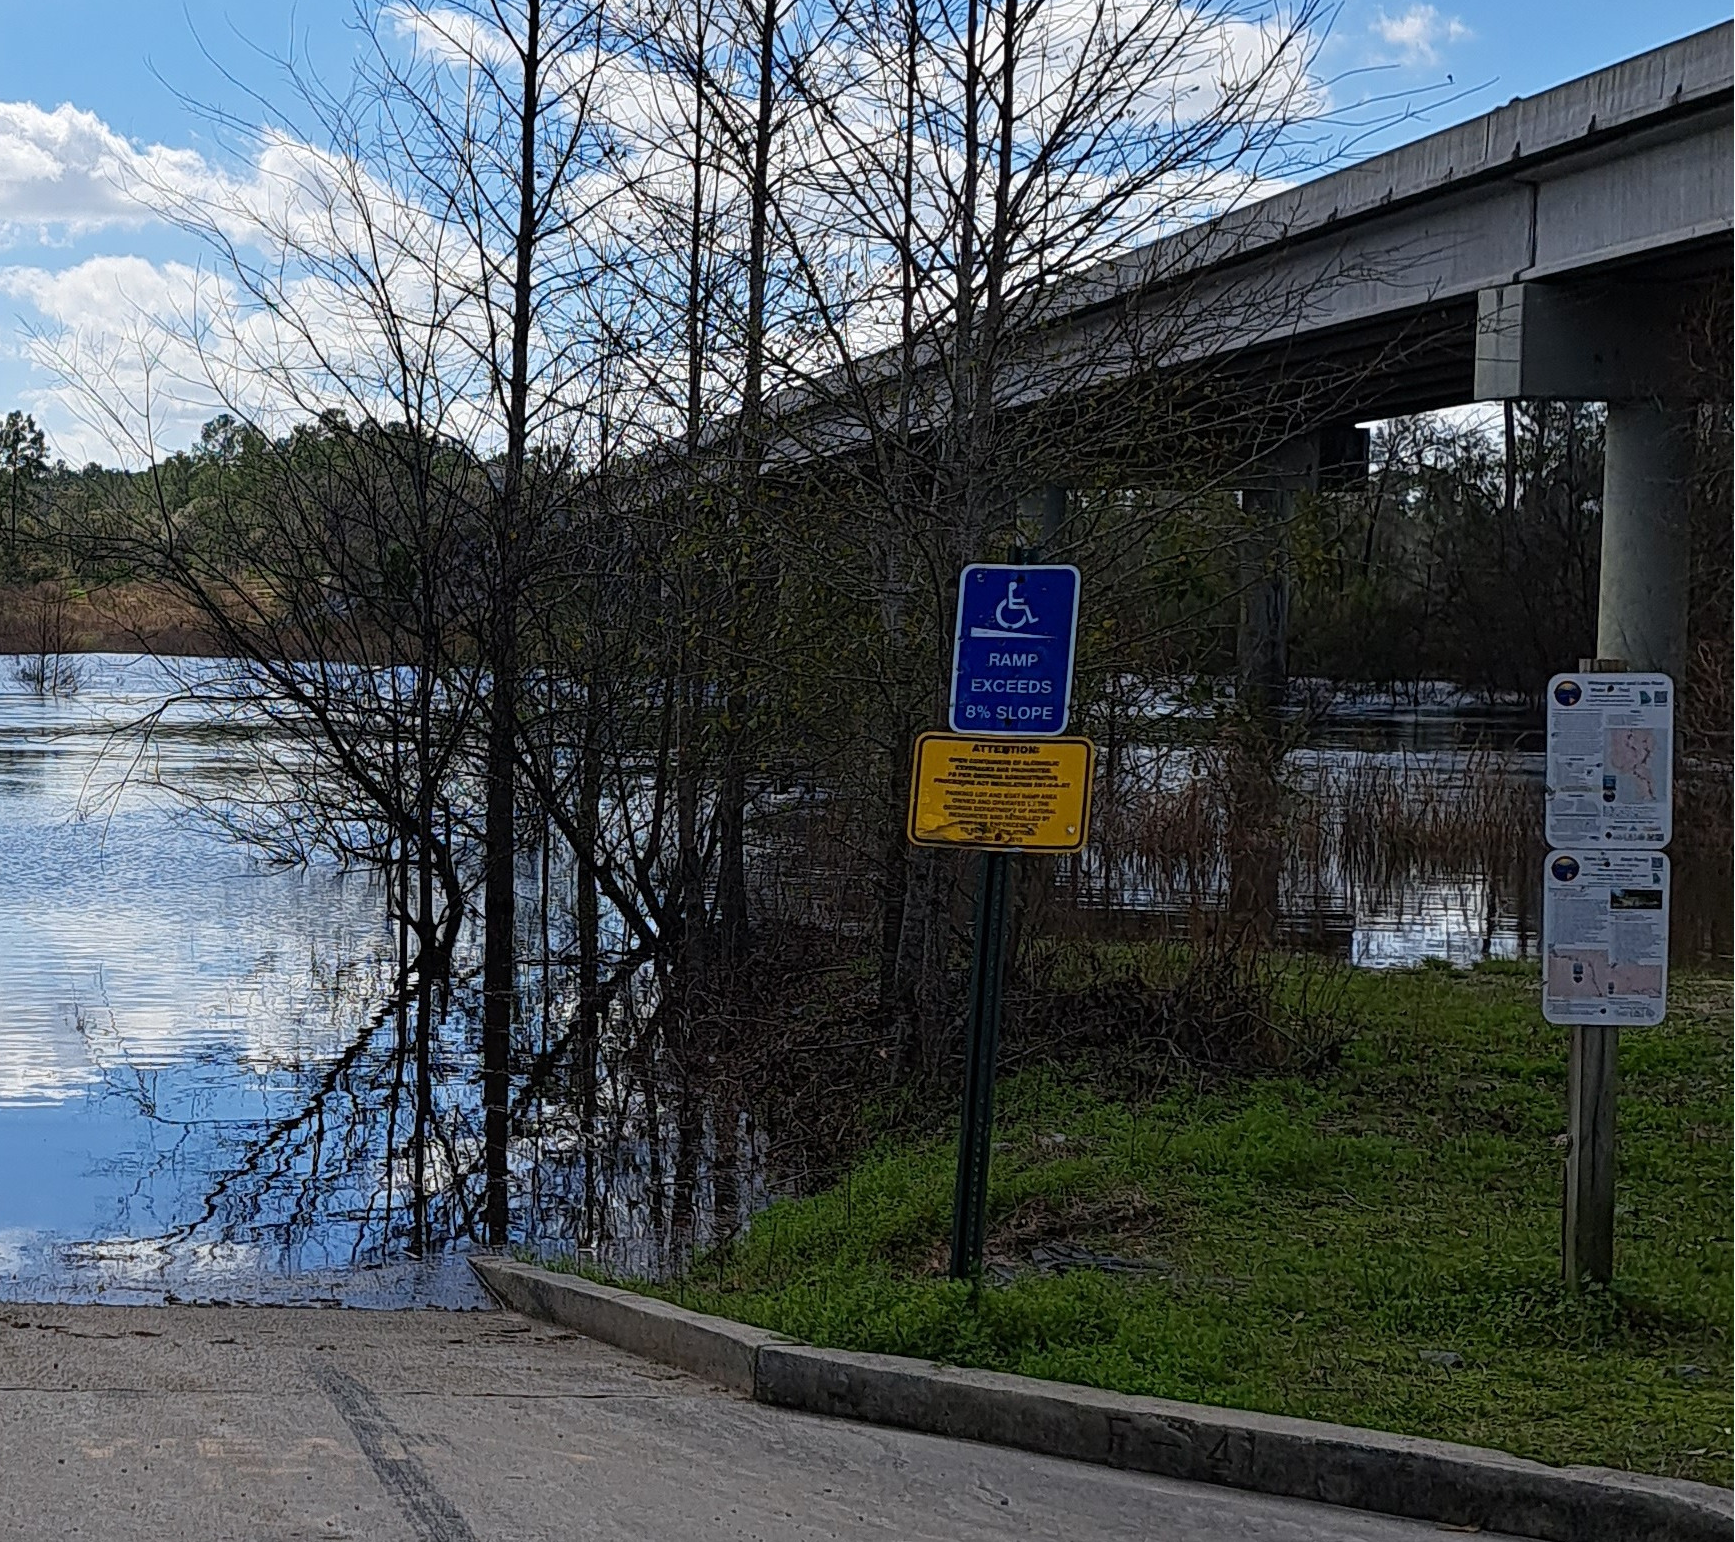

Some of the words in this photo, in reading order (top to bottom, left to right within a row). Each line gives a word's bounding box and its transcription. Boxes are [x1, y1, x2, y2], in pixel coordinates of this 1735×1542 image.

[988, 652, 1039, 667] RAMP
[971, 678, 1053, 694] EXCEEDS
[965, 704, 991, 719] 8%
[995, 705, 1054, 720] SLOPE
